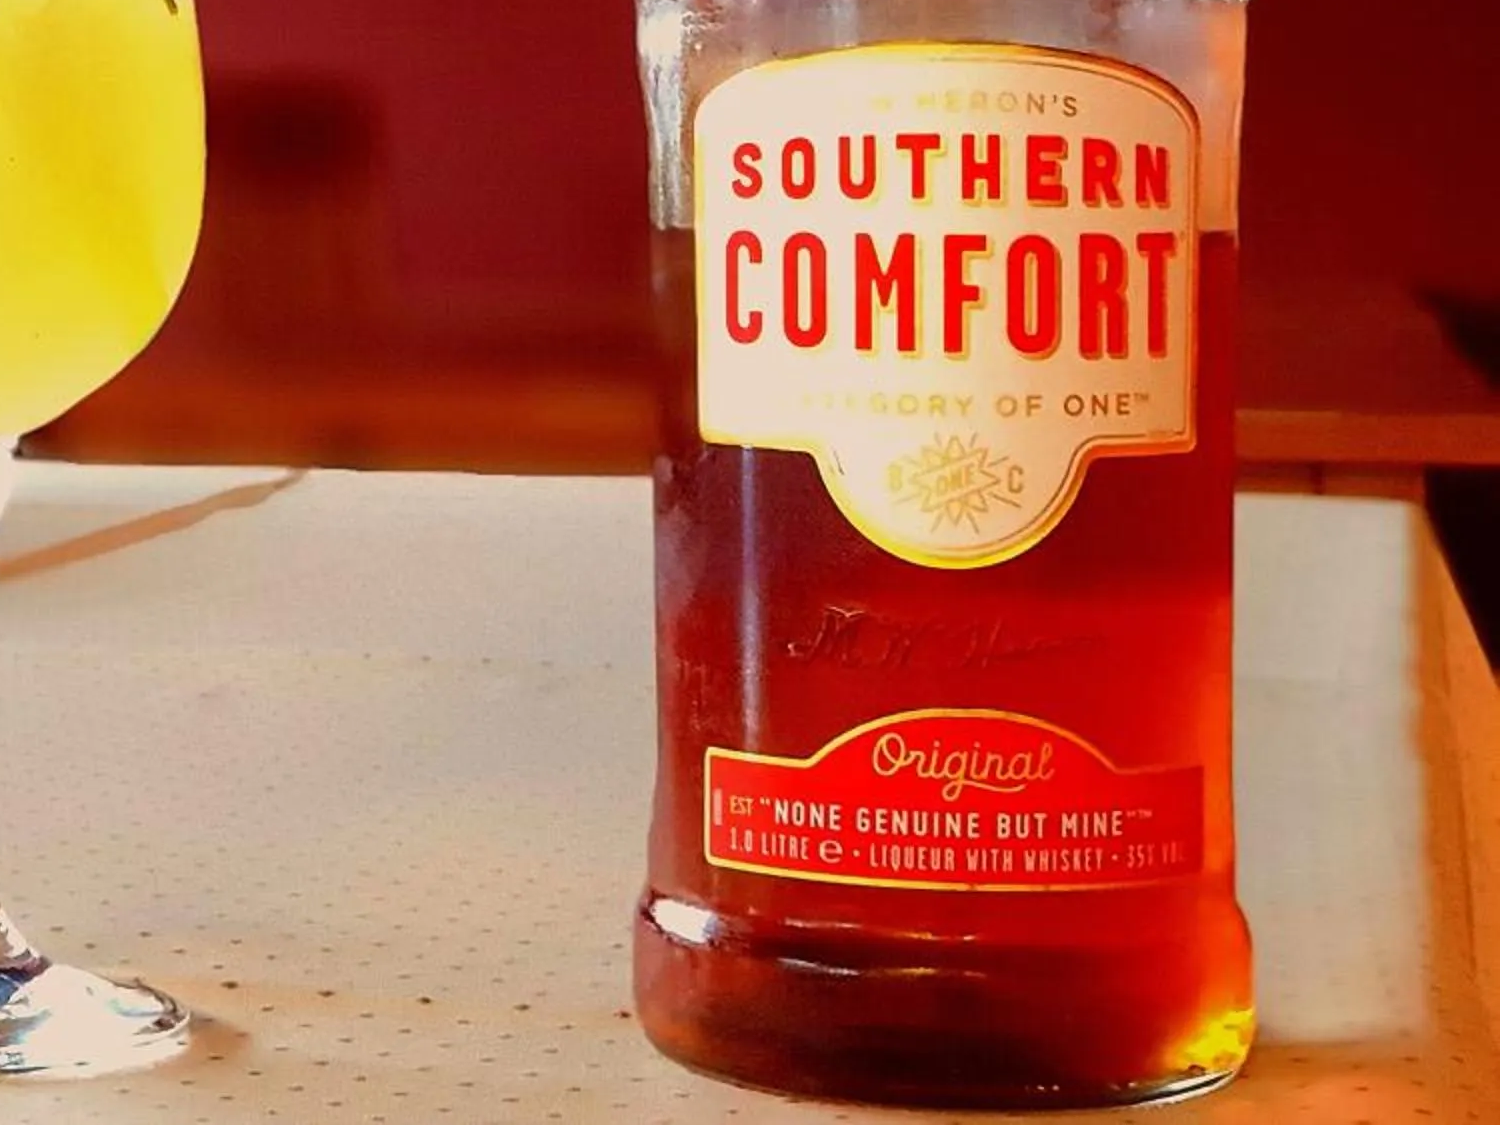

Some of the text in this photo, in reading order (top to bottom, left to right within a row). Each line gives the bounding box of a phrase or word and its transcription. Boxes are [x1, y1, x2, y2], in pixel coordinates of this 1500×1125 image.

[731, 133, 1171, 207] SOUTHERN
[725, 229, 1176, 360] COMFORT
[994, 394, 1044, 419] OF
[936, 465, 977, 496] ONE
[1007, 464, 1025, 495] C
[872, 732, 1056, 802] Original
[729, 795, 754, 816] EST
[855, 806, 981, 840] GENUINE
[996, 812, 1048, 840] BUT
[730, 826, 754, 853] 1.0
[761, 832, 810, 861] LITRE
[869, 842, 956, 872] LIQUEUR
[966, 848, 1014, 873] WITH
[1024, 847, 1104, 873] WHISKEY
